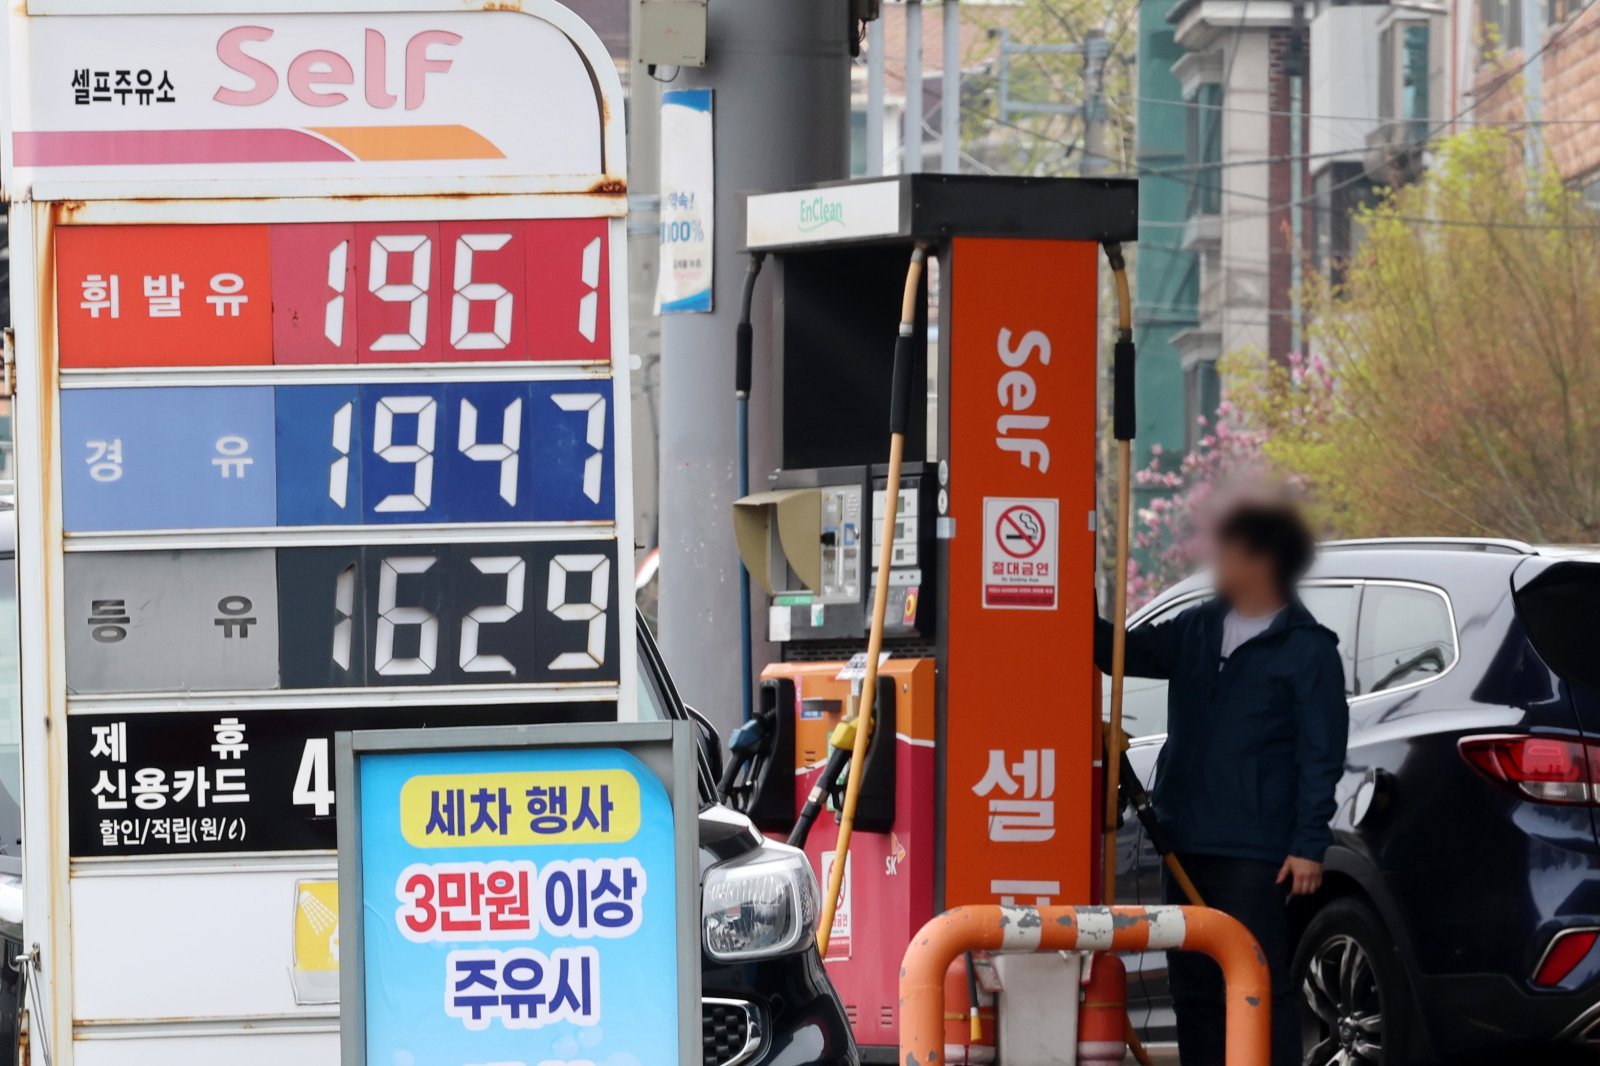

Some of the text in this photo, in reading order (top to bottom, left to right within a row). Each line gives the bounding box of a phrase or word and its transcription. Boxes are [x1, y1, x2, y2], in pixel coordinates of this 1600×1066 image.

[71, 68, 176, 106] 셀프주유소
[213, 26, 463, 109] Self
[800, 197, 843, 222] EnClean
[324, 233, 601, 351] 1961
[996, 327, 1051, 474] Self
[329, 394, 606, 513] 1947
[332, 554, 611, 675] 1629
[91, 766, 250, 810] 신용카드
[292, 738, 335, 816] 4
[427, 784, 613, 837] 세차 행사
[885, 856, 897, 875] SK
[405, 867, 637, 932] 3만원 이상
[454, 956, 592, 1020] 주유시
